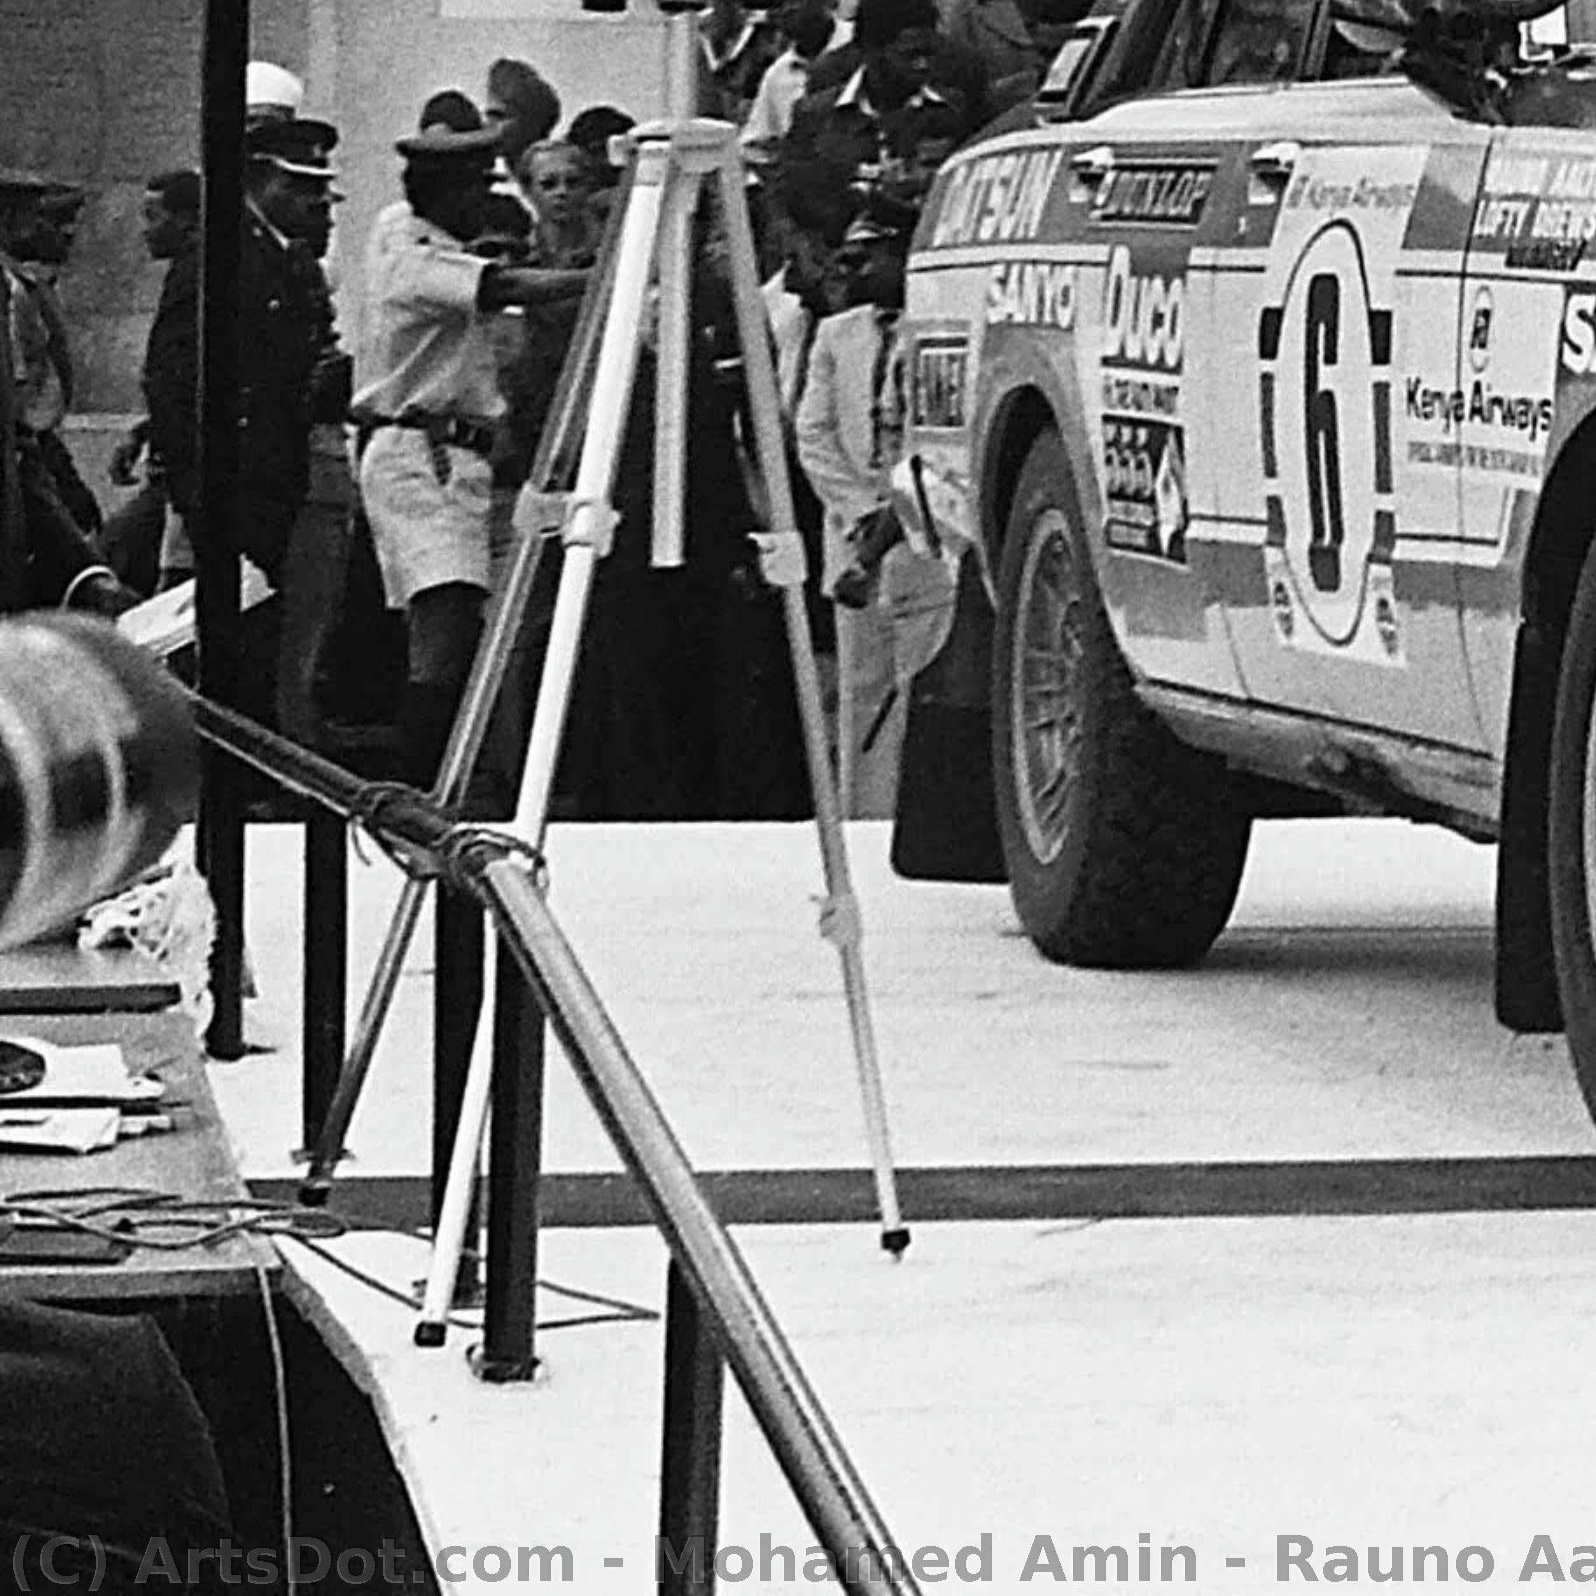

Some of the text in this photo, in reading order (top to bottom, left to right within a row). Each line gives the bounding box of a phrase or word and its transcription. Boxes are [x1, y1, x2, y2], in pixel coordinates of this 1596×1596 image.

[985, 261, 1077, 330] SANYO
[1304, 272, 1343, 593] 6
[1406, 375, 1552, 442] Kenya Airways
